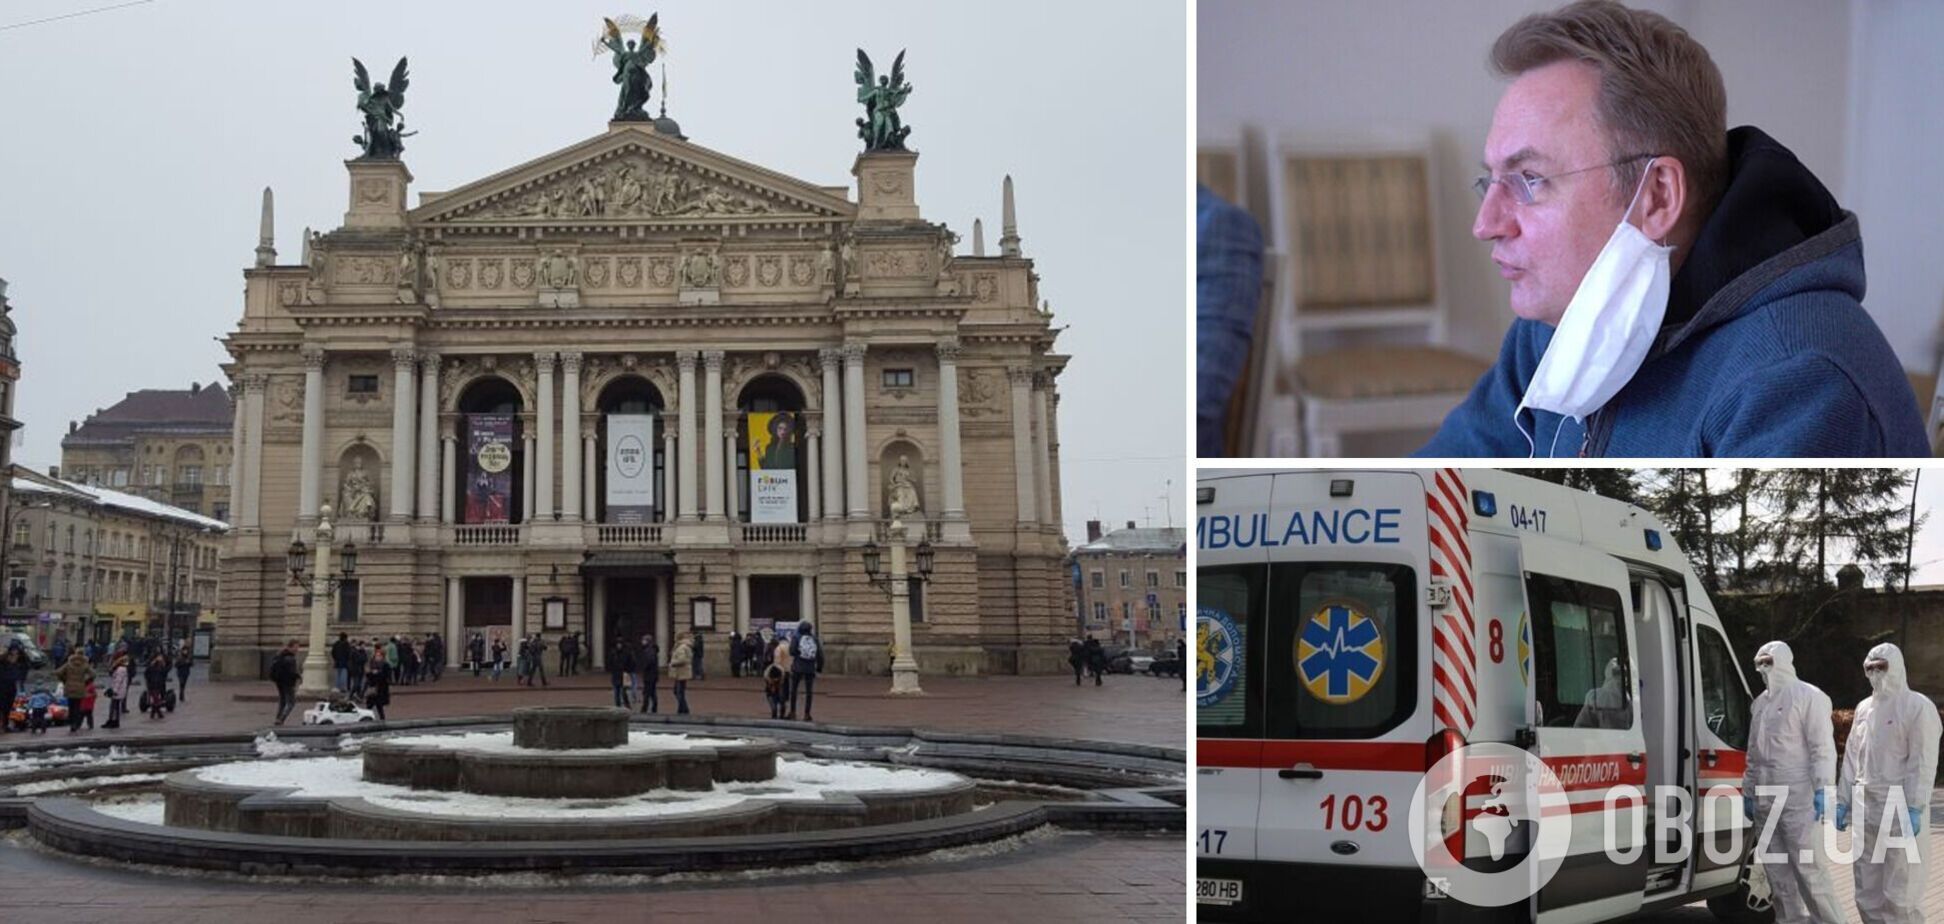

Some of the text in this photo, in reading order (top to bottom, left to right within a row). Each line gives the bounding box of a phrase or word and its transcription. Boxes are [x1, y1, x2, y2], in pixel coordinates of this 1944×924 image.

[1510, 504, 1546, 533] 04-17
[1489, 618, 1504, 664] 8
[1558, 761, 1620, 788] ДОПОМОГА
[1320, 794, 1388, 832] 103
[1197, 829, 1227, 854] 17
